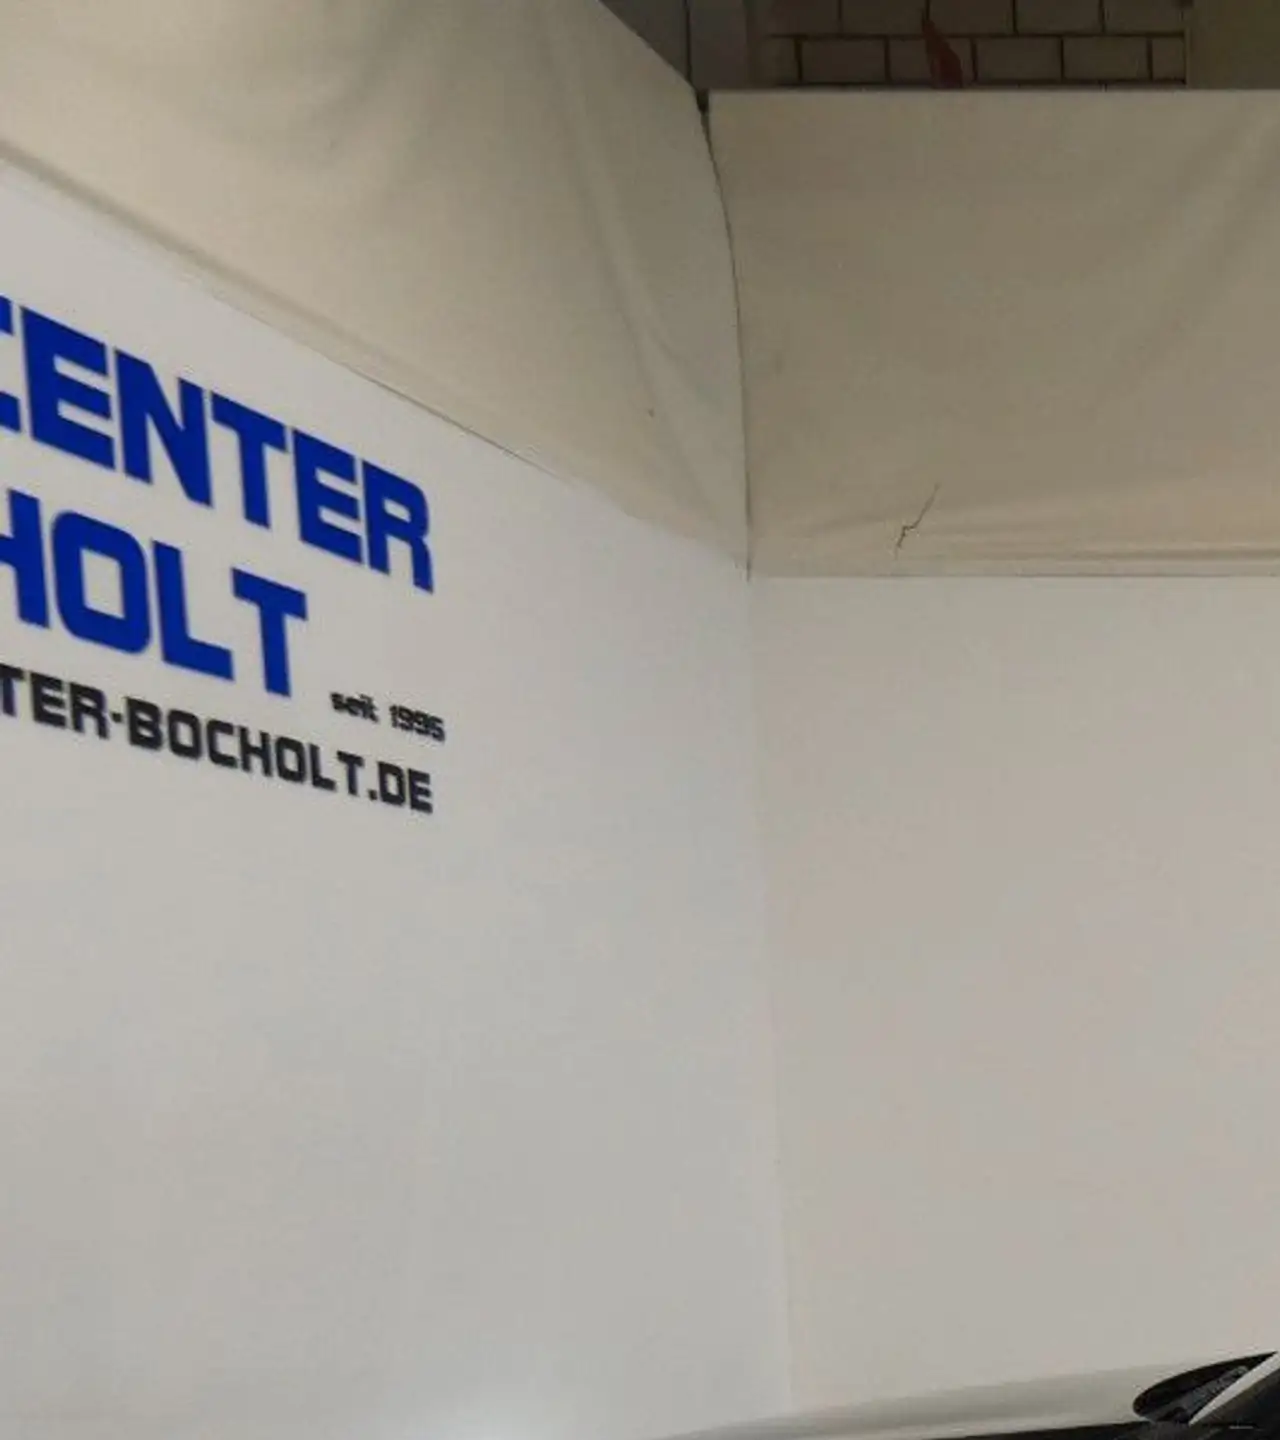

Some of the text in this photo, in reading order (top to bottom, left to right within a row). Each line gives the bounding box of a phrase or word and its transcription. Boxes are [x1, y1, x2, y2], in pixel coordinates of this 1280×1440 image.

[0, 295, 433, 594] ENTER
[331, 692, 379, 723] seit
[389, 704, 445, 742] 1995
